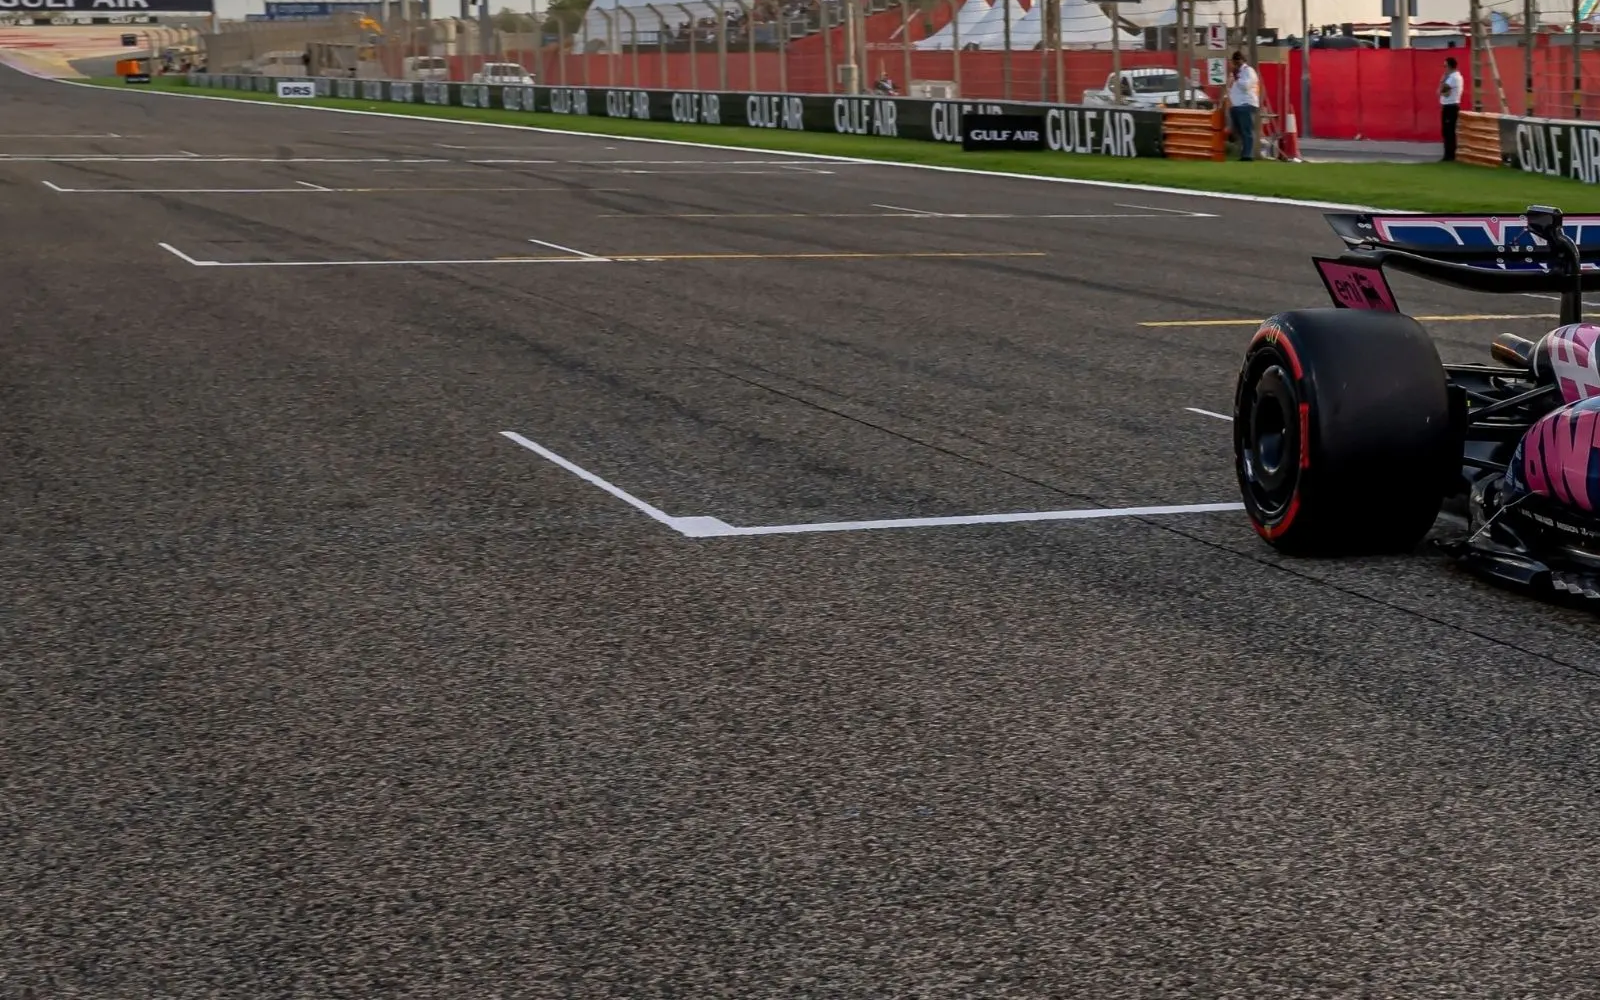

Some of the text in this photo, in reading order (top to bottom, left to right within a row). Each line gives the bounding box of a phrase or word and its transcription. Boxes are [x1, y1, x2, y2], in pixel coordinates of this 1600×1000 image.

[282, 86, 312, 96] DRS
[672, 92, 721, 124] GULF AIR
[747, 95, 804, 130] GULF AIR
[833, 98, 897, 137] GULF AIR
[931, 102, 972, 143] GUL
[970, 129, 1040, 142] GULF AIR
[1046, 109, 1137, 158] GULF AIR
[1516, 123, 1563, 176] GULF
